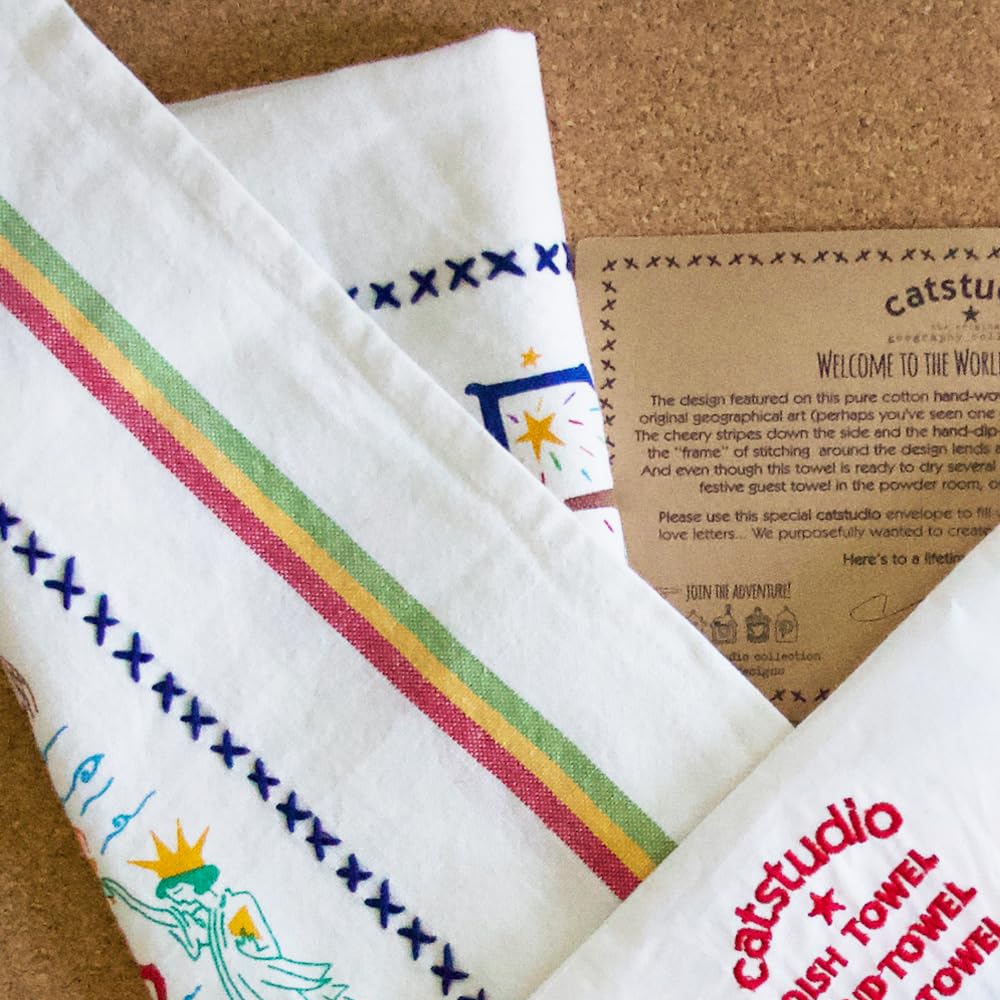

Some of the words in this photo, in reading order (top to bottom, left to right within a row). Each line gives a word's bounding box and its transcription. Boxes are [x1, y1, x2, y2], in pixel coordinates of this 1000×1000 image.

[651, 394, 676, 406] The
[680, 394, 725, 407] design
[730, 393, 788, 405] featured
[793, 394, 812, 404] on
[816, 392, 840, 404] this
[844, 394, 877, 404] pure
[882, 391, 929, 403] cotton
[639, 412, 688, 426] original
[692, 410, 783, 426] geographical
[787, 411, 806, 422] art
[810, 409, 875, 423] (perhaps
[878, 408, 925, 423] you've
[929, 409, 963, 419] seen
[967, 408, 995, 419] one
[634, 429, 659, 442] The
[663, 429, 712, 443] cheery
[716, 429, 762, 442] stripes
[766, 428, 809, 440] down
[813, 427, 835, 439] the
[840, 426, 870, 439] side
[874, 426, 901, 438] and
[905, 426, 928, 437] the
[648, 447, 670, 459] the
[734, 445, 749, 457] of
[753, 445, 810, 459] stitching
[819, 444, 869, 456] around
[874, 443, 896, 455] the
[901, 443, 948, 457] design
[952, 442, 989, 454] lends
[640, 464, 671, 477] And
[675, 465, 709, 476] even
[714, 463, 763, 477] though
[767, 463, 791, 475] this
[795, 463, 836, 475] towel
[840, 462, 850, 474] is
[855, 461, 896, 475] ready
[900, 461, 914, 473] to
[919, 461, 944, 474] dry
[948, 460, 997, 473] several
[699, 481, 744, 494] festive
[748, 481, 787, 495] guest
[790, 480, 831, 492] towel
[835, 480, 848, 491] in
[853, 479, 875, 491] the
[879, 478, 936, 492] powder
[658, 511, 702, 523] Please
[706, 512, 731, 522] use
[735, 510, 758, 522] this
[763, 509, 812, 523] special
[816, 507, 882, 521] catstudio
[886, 507, 951, 522] envelope
[957, 507, 972, 519] to
[658, 528, 688, 540] love
[752, 528, 773, 539] We
[778, 525, 866, 542] purposefully
[870, 525, 923, 537] wanted
[928, 525, 943, 537] to
[842, 553, 889, 565] Here's
[892, 554, 907, 565] to
[911, 555, 920, 564] a
[686, 584, 712, 601] JOIN
[716, 583, 730, 599] THE
[732, 797, 903, 993] catstudio
[840, 849, 940, 946] TOWEL
[877, 882, 977, 980] TOWEL
